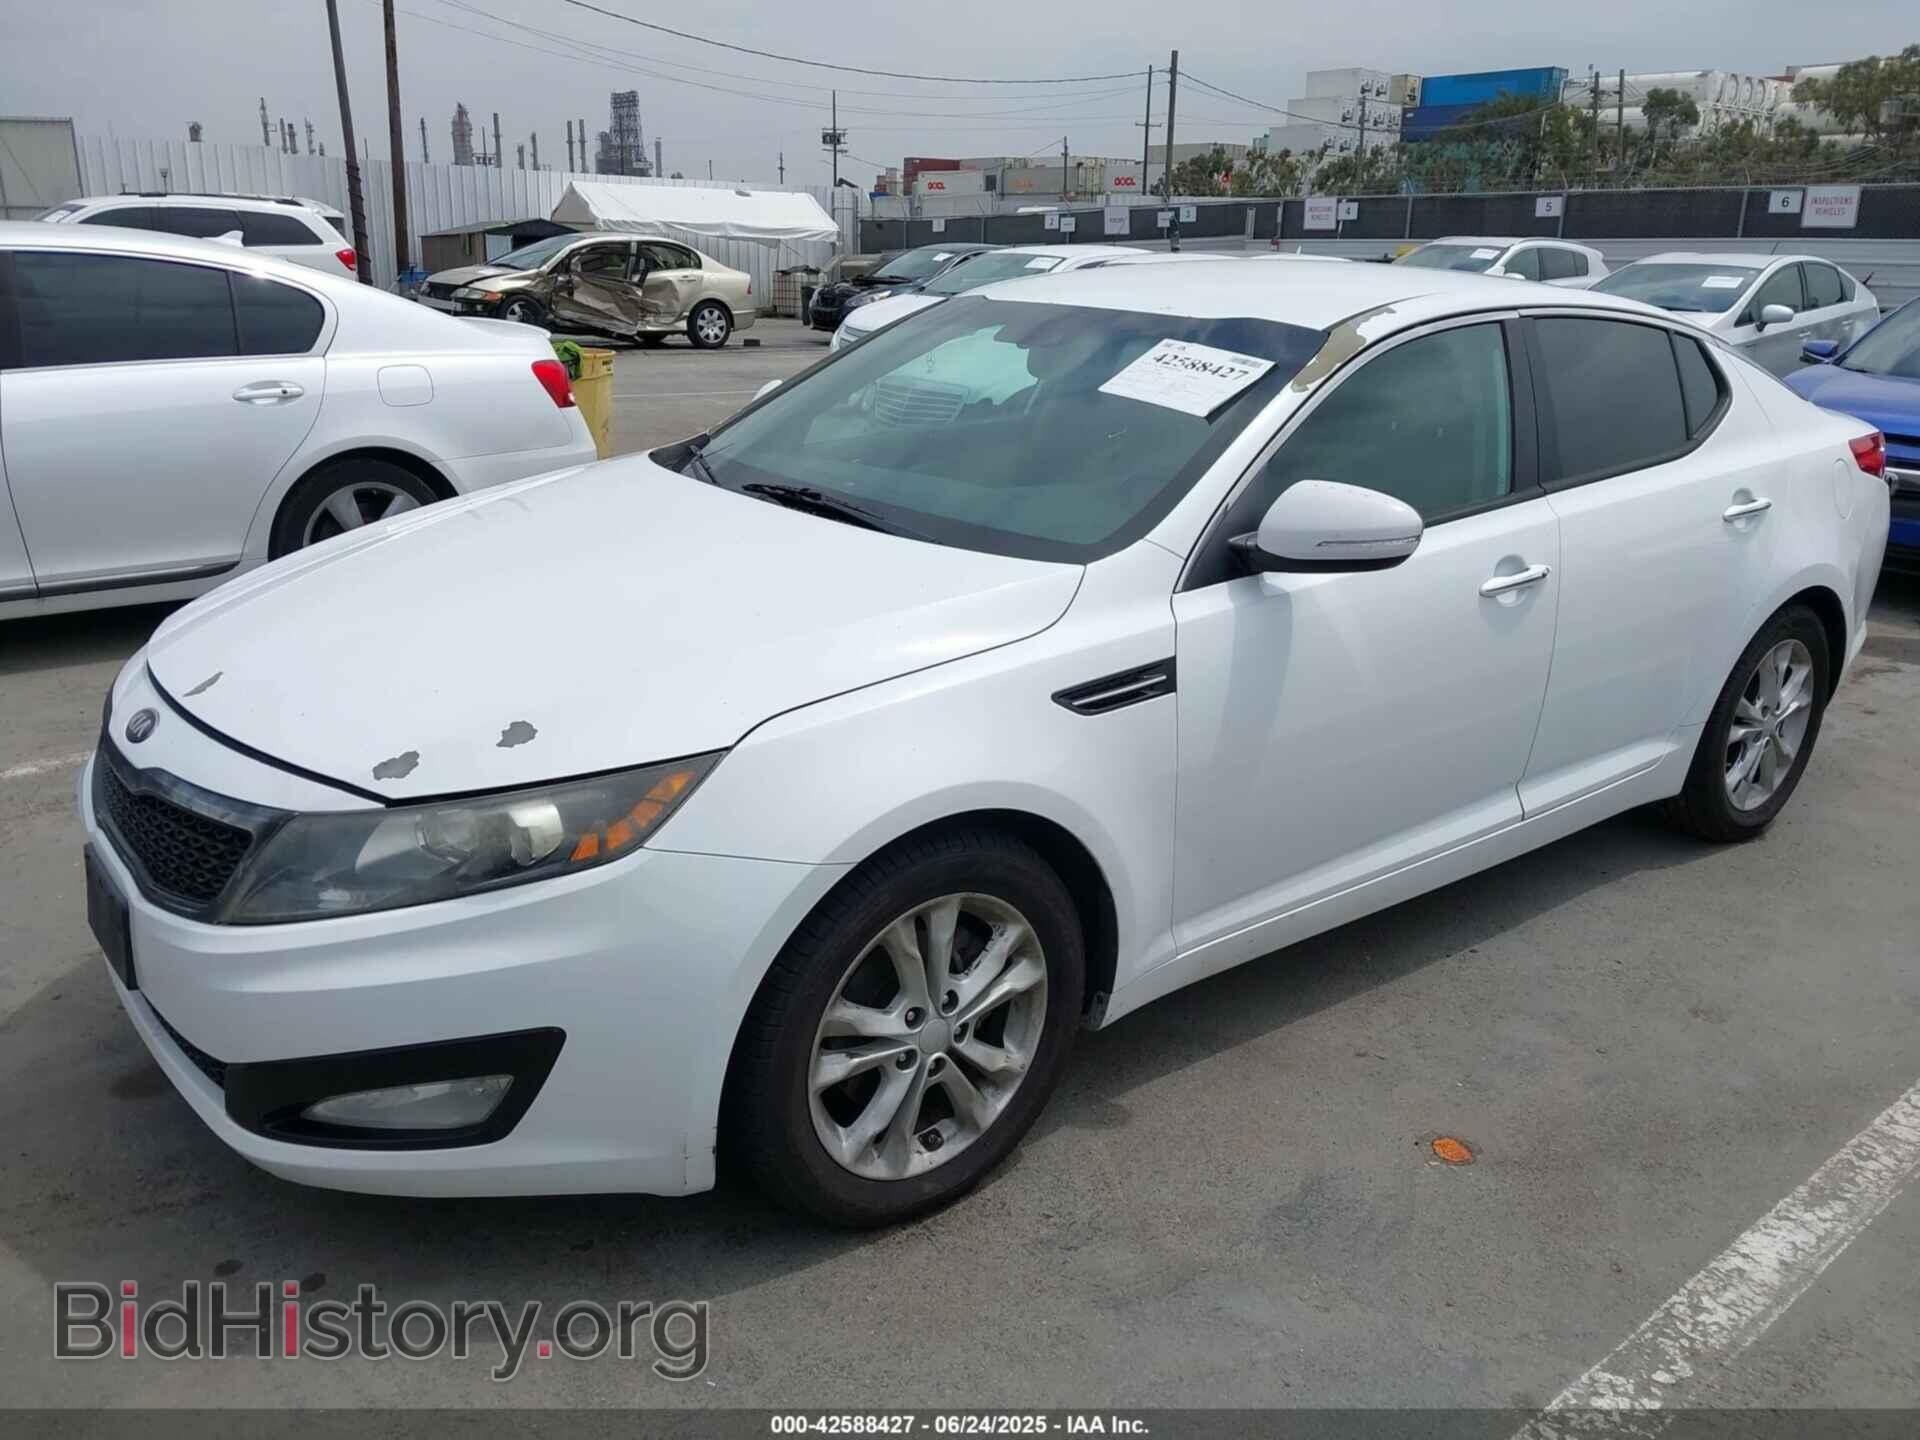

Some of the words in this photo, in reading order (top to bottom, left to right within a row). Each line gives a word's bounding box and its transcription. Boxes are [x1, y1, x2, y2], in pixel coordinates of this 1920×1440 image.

[1545, 201, 1553, 212] 5
[1781, 196, 1790, 208] 6
[1153, 352, 1249, 381] 42588427
